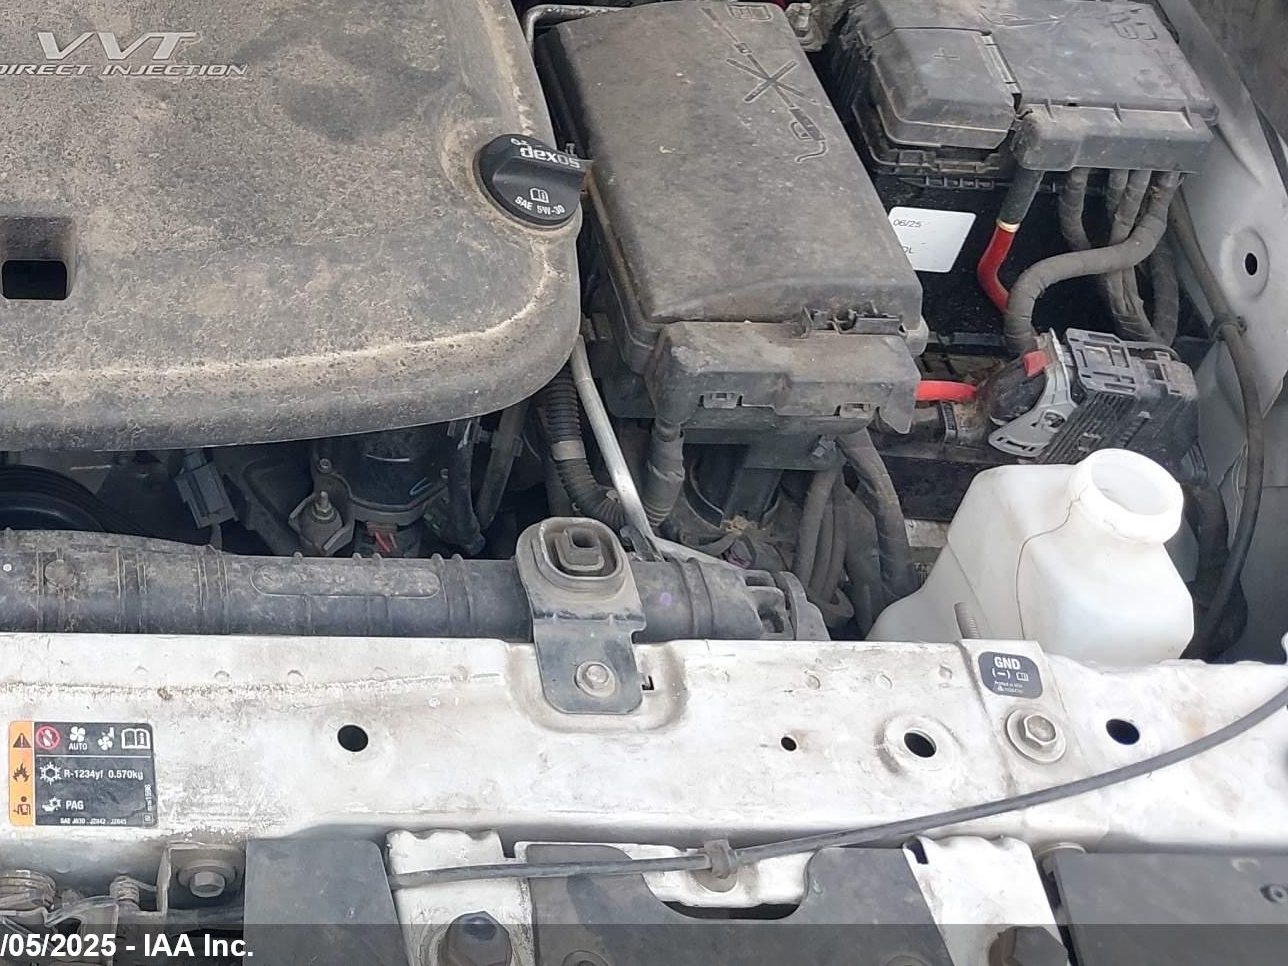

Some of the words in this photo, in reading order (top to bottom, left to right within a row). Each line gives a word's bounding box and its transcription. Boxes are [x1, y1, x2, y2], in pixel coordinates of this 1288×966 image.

[37, 31, 200, 61] VVT
[102, 64, 248, 77] INJECTION
[520, 144, 581, 169] dexos
[514, 195, 533, 210] SAE
[537, 204, 565, 215] 5W-30
[893, 218, 922, 228] 06/25
[994, 656, 1021, 670] GND
[68, 742, 88, 751] AUTO
[63, 769, 104, 780] R-1234yf
[65, 800, 85, 810] PAG
